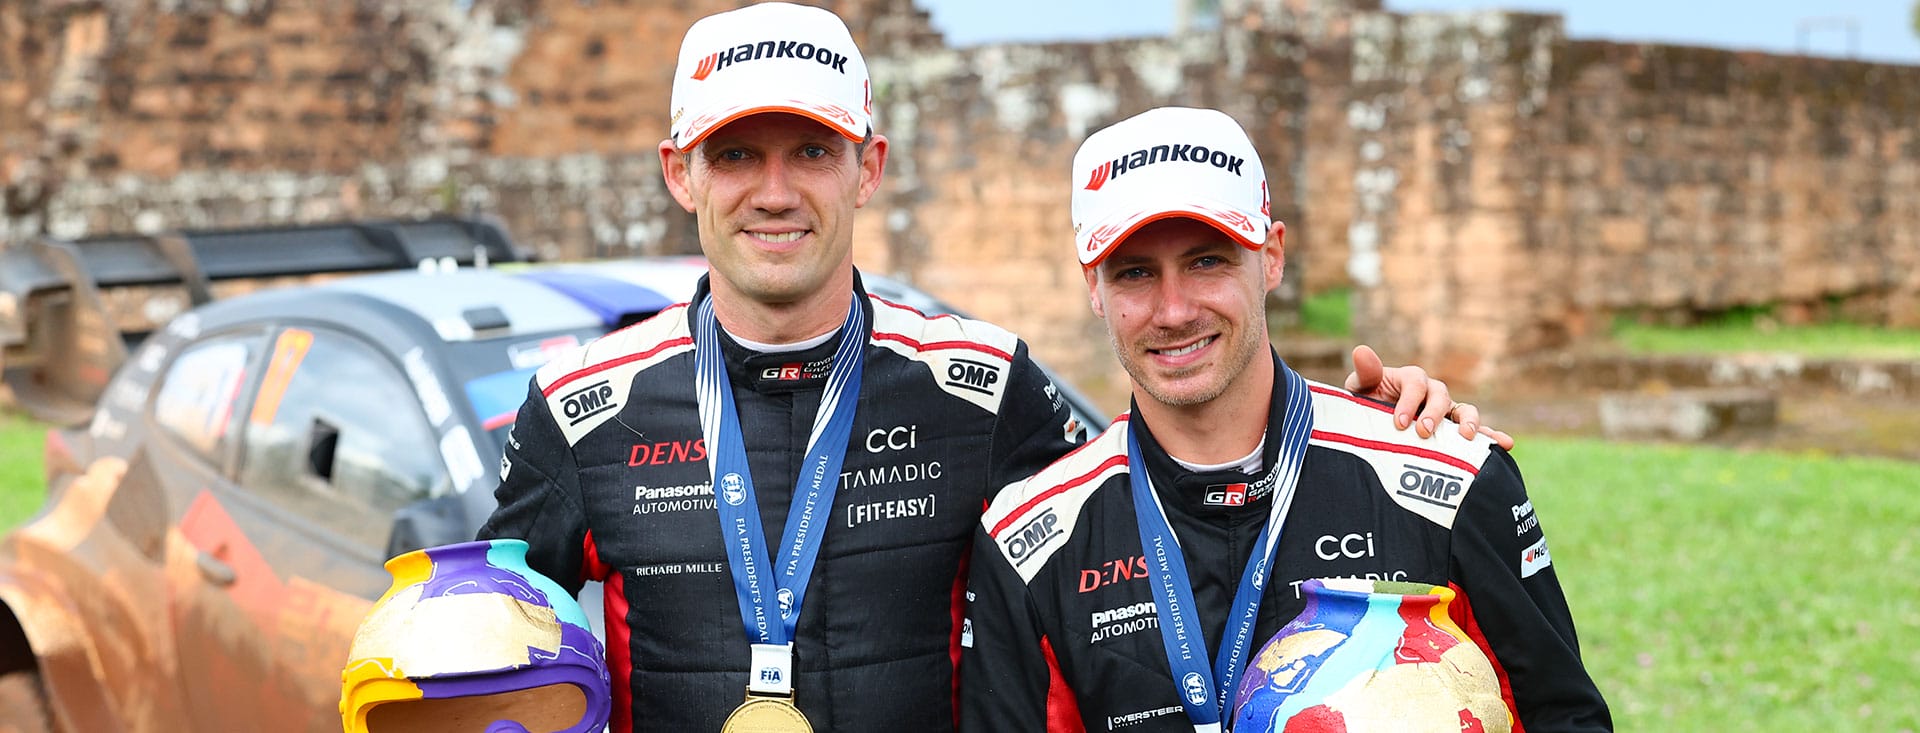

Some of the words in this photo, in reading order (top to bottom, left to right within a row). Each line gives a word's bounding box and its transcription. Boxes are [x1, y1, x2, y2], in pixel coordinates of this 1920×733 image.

[762, 367, 799, 379] GR
[807, 355, 835, 367] TOYOT
[948, 362, 998, 388] OMP
[563, 385, 613, 419] OMP
[628, 438, 708, 467] DENS
[840, 461, 942, 490] TAMADIC
[1249, 462, 1278, 490] TOYOT
[1400, 470, 1462, 502] OMP
[635, 481, 715, 500] Panasonic
[1206, 491, 1244, 505] GR
[735, 517, 747, 535] FIA
[786, 559, 798, 576] FIA
[792, 490, 818, 557] PRESIDENT'S
[815, 454, 829, 490] MEDAL
[1008, 512, 1058, 560] OMP
[1153, 535, 1170, 572] MEDAL
[636, 565, 682, 576] RICHARD
[685, 563, 722, 574] MILLE
[740, 537, 762, 603] PRESIDENT'S
[1078, 556, 1149, 593] DENS
[1162, 574, 1186, 640] PRESIDENT'S
[1245, 601, 1257, 620] FIA
[754, 606, 769, 642] MEDAL
[1180, 642, 1192, 660] FIA
[1224, 621, 1250, 687] PRESIDENT'S
[1113, 705, 1184, 724] OVERSTEER
[1218, 688, 1227, 713] MED
